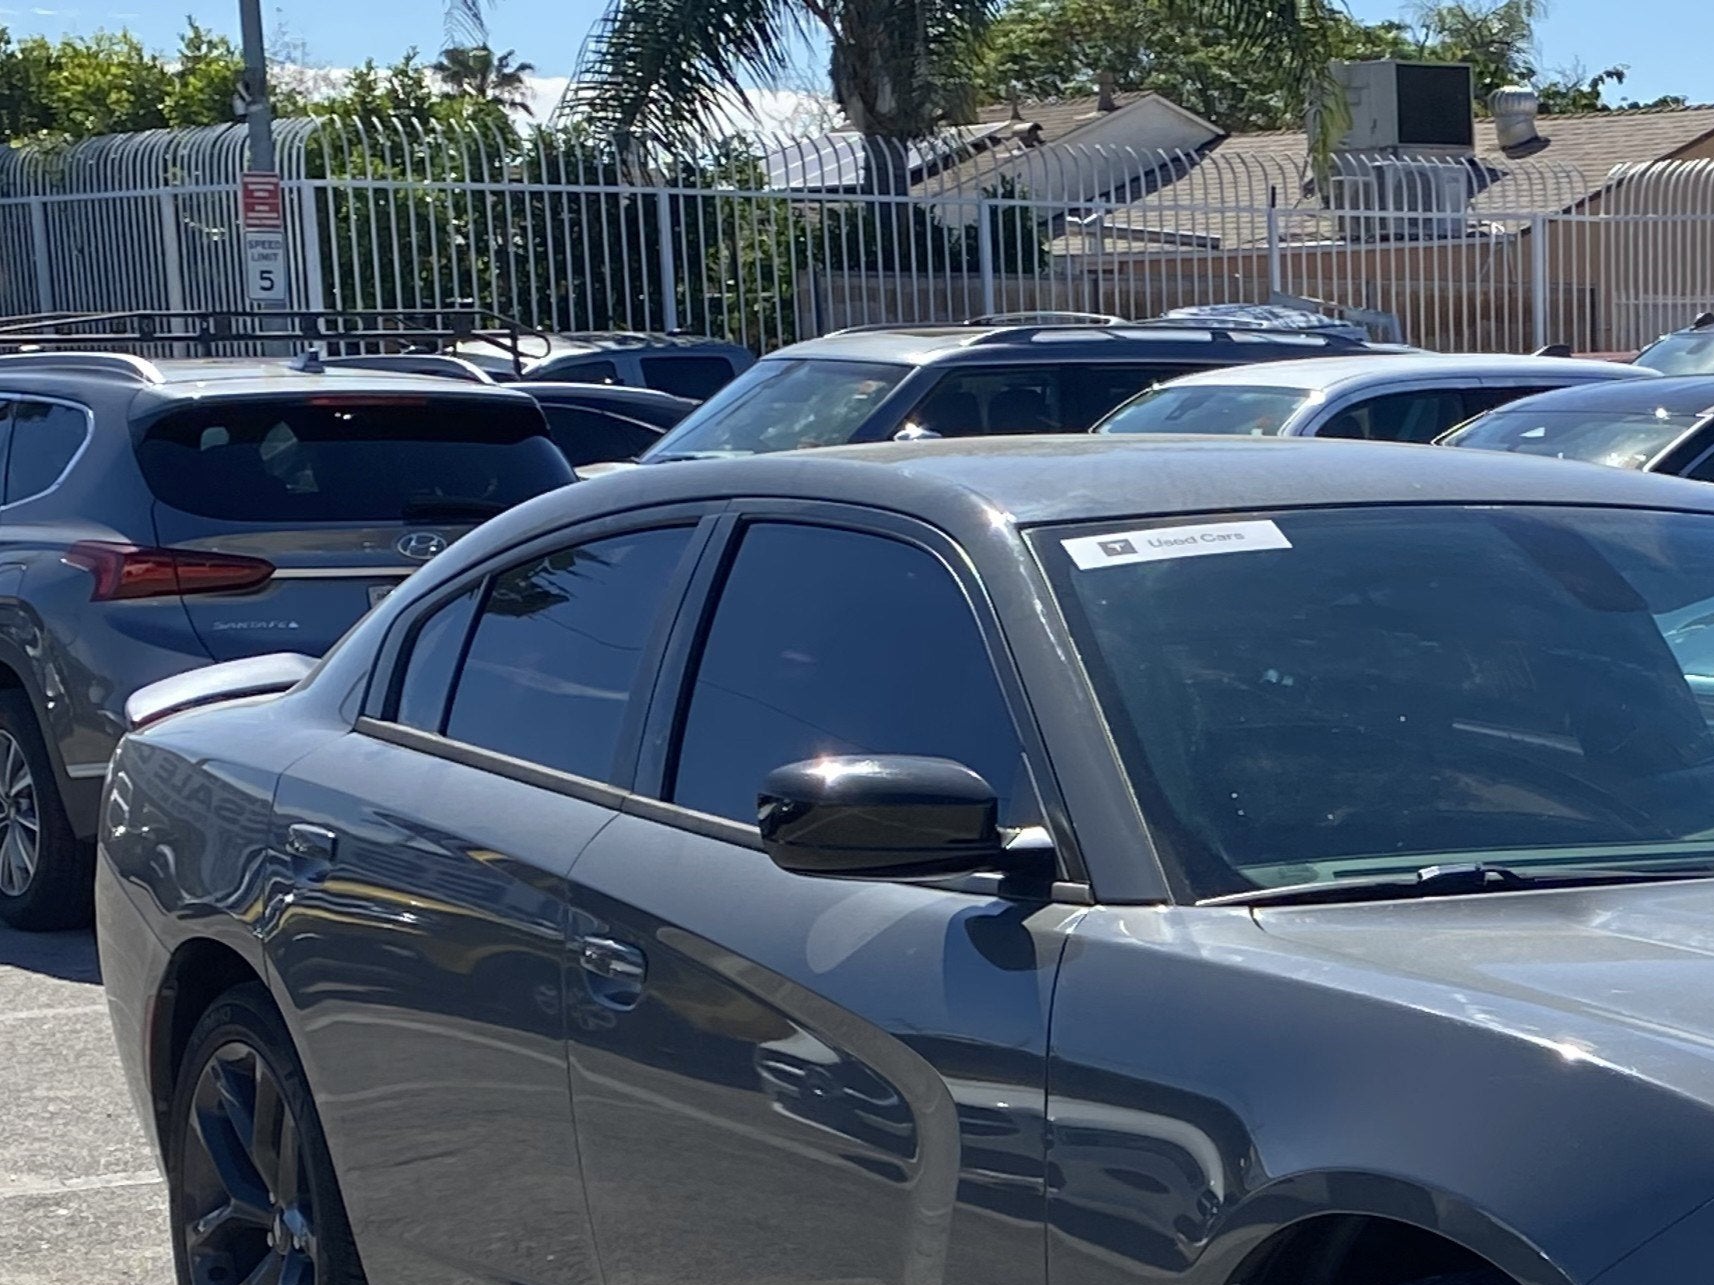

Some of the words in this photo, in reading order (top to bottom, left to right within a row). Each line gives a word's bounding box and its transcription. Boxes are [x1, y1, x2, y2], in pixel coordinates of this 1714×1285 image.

[248, 240, 282, 250] SPEED
[251, 252, 279, 262] LIMIT
[259, 270, 275, 291] 5
[1147, 536, 1198, 549] Used
[1200, 532, 1245, 543] Cars
